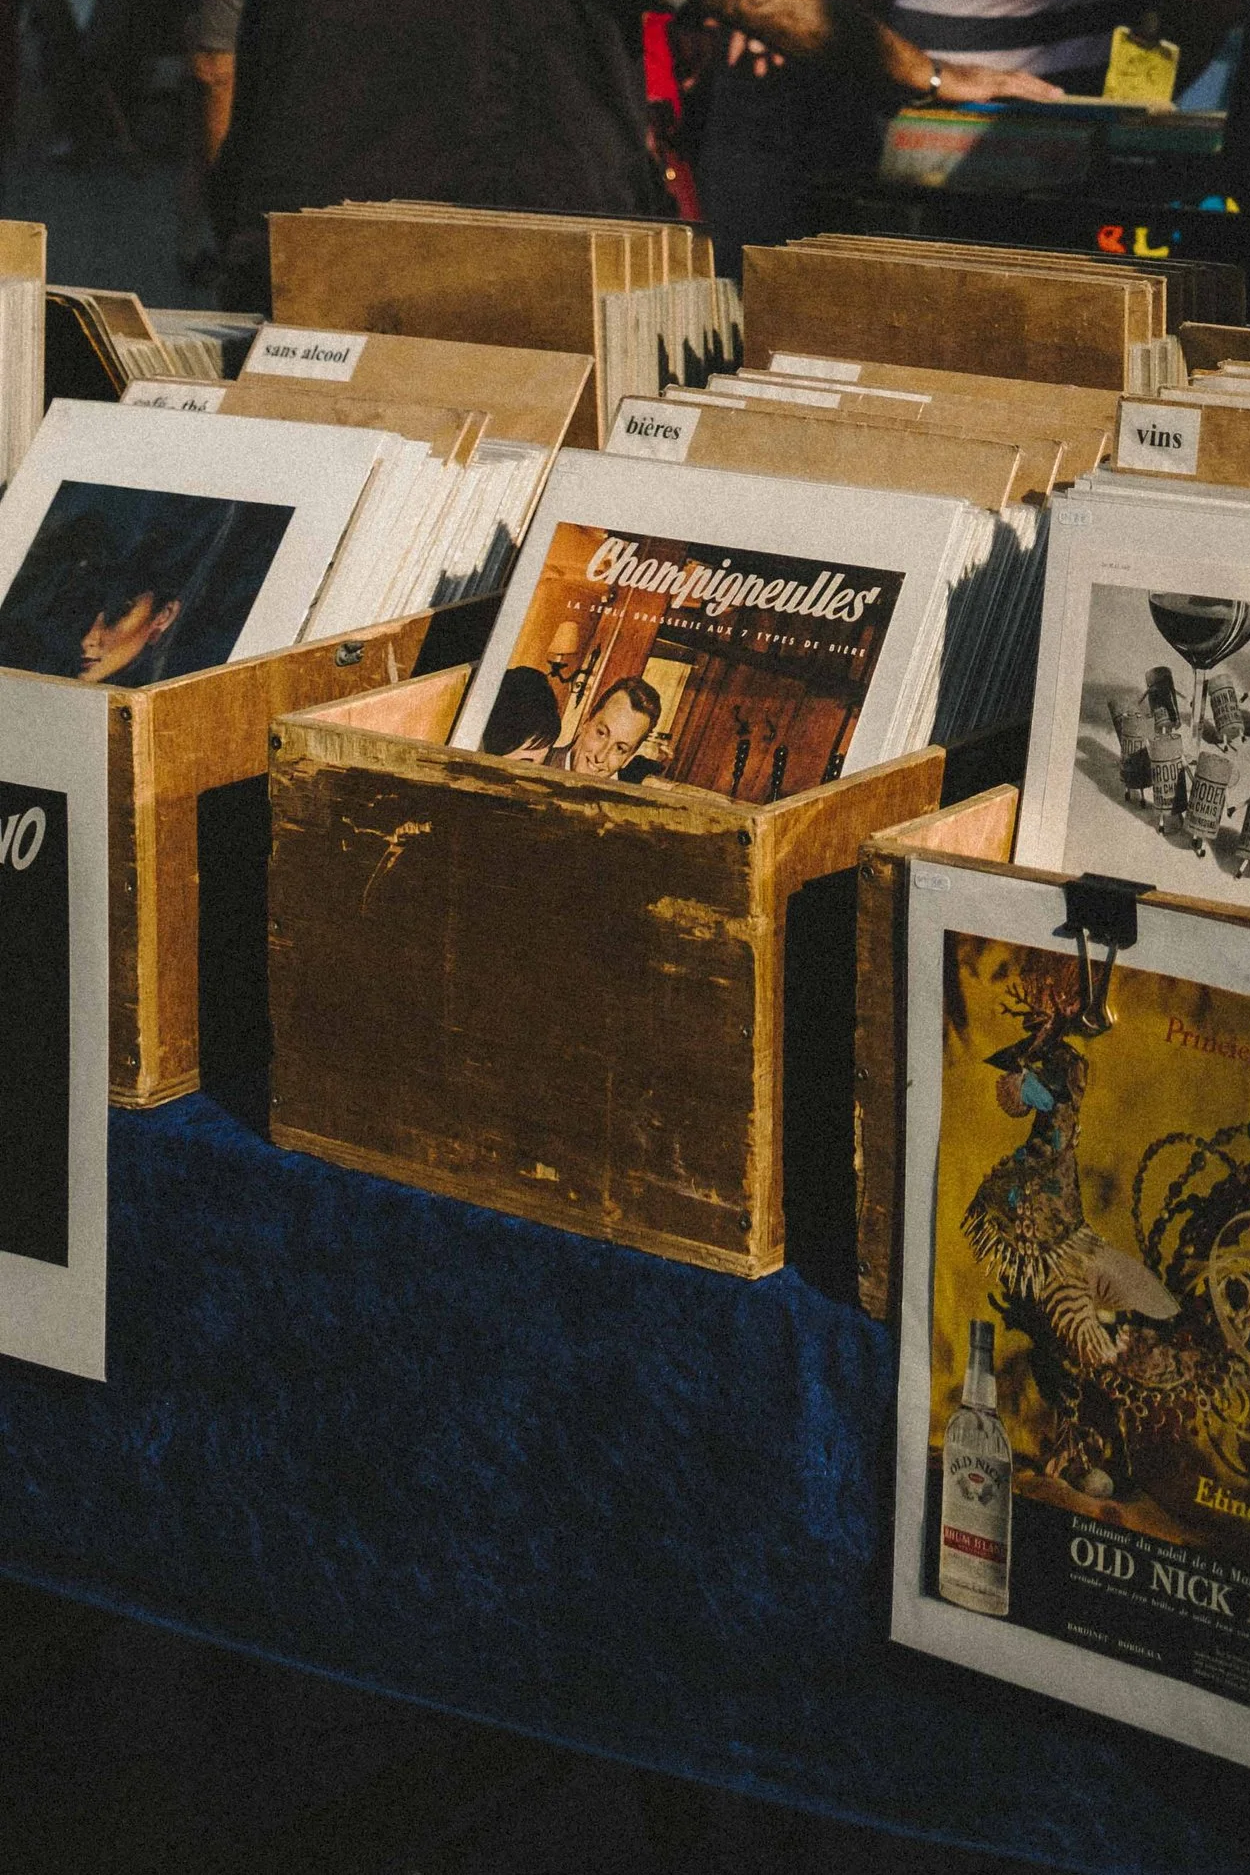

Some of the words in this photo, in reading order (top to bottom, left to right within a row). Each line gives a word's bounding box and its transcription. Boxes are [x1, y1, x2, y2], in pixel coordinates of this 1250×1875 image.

[264, 341, 298, 360] sans
[301, 344, 352, 364] alcool
[626, 415, 682, 441] bières
[1136, 423, 1182, 449] vins
[585, 535, 881, 623] Champigneulles
[566, 599, 581, 610] LA
[633, 611, 702, 631] BRASSERIE
[706, 623, 733, 636] AUX
[741, 628, 749, 638] 7
[755, 631, 796, 646] TYPES
[803, 639, 820, 650] DE
[949, 1454, 973, 1477] OLD
[1071, 1514, 1131, 1546] Enflammé
[1135, 1532, 1151, 1553] du
[1157, 1544, 1187, 1566] soleil
[1192, 1555, 1207, 1570] de
[1212, 1560, 1224, 1576] la
[1069, 1535, 1136, 1581] OLD
[1149, 1559, 1235, 1618] NICK
